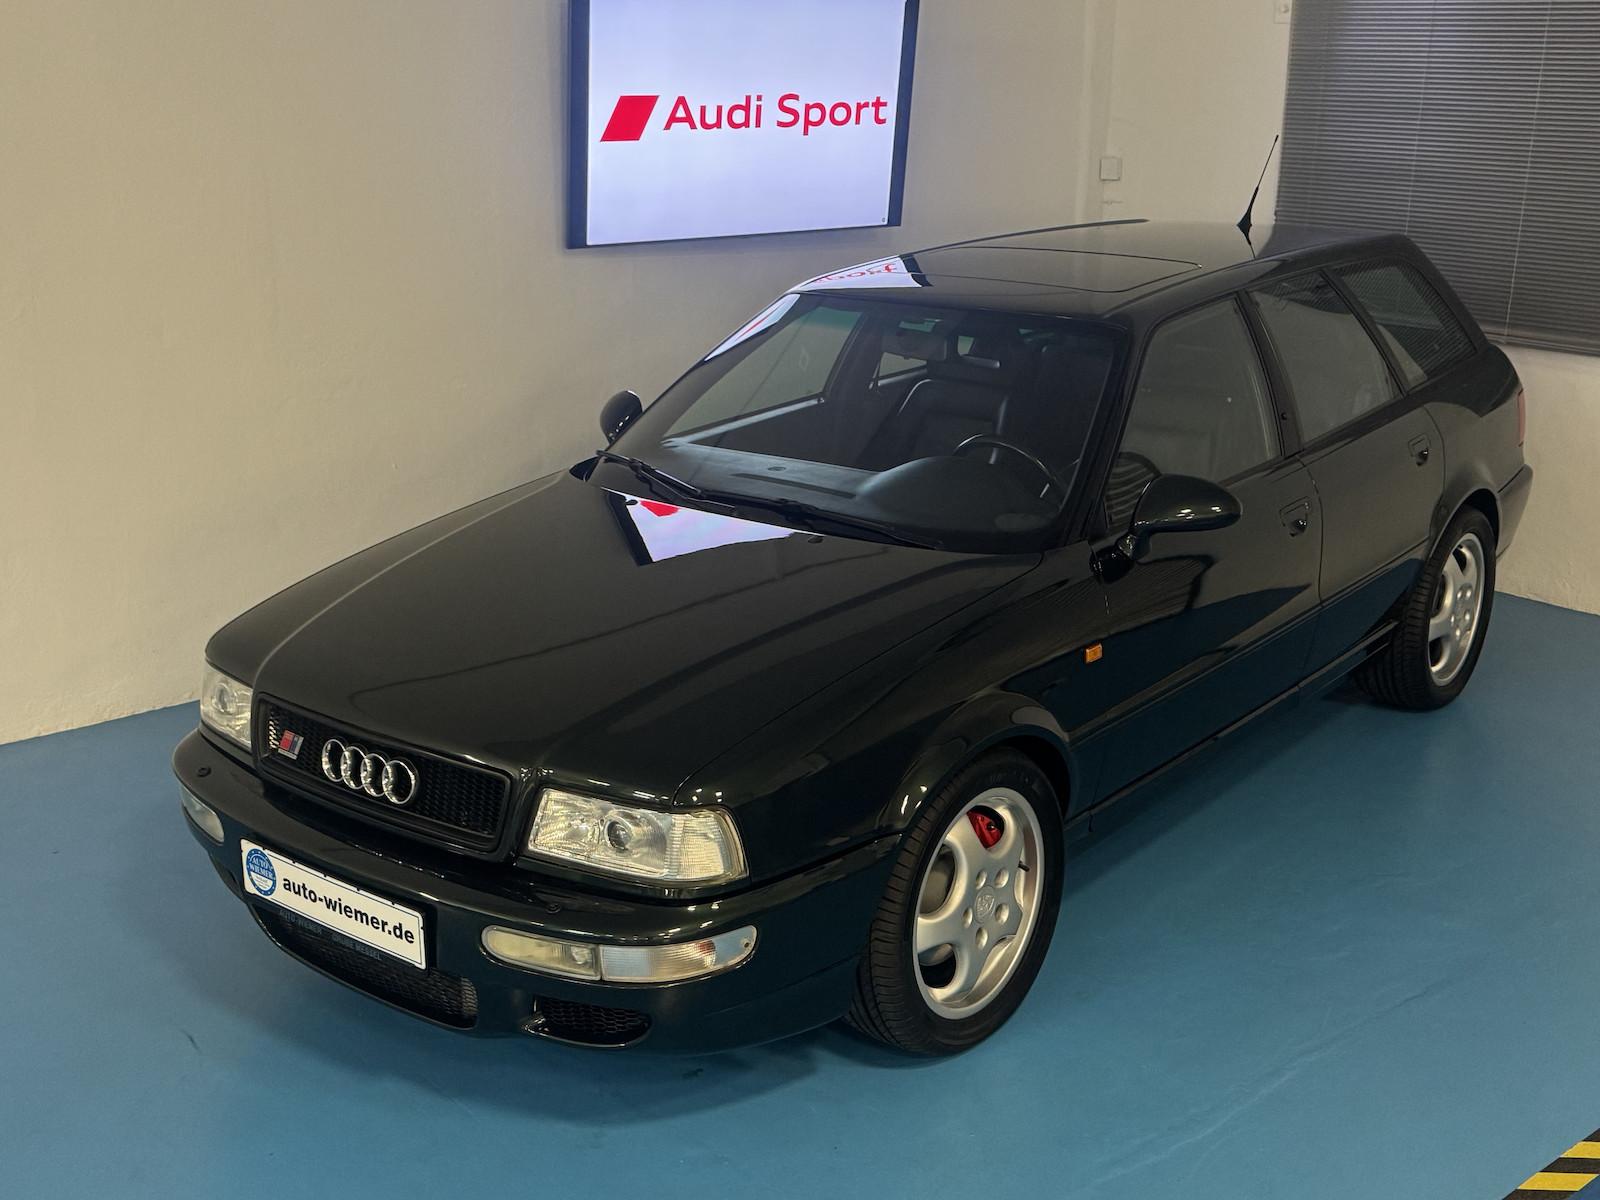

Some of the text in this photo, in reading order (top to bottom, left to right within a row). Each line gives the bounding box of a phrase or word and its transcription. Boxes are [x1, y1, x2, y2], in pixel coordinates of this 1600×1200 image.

[662, 92, 889, 137] Audi Sport
[249, 863, 274, 879] WIEMER
[252, 856, 270, 869] AUTO
[282, 877, 416, 944] auto-wiemer.de
